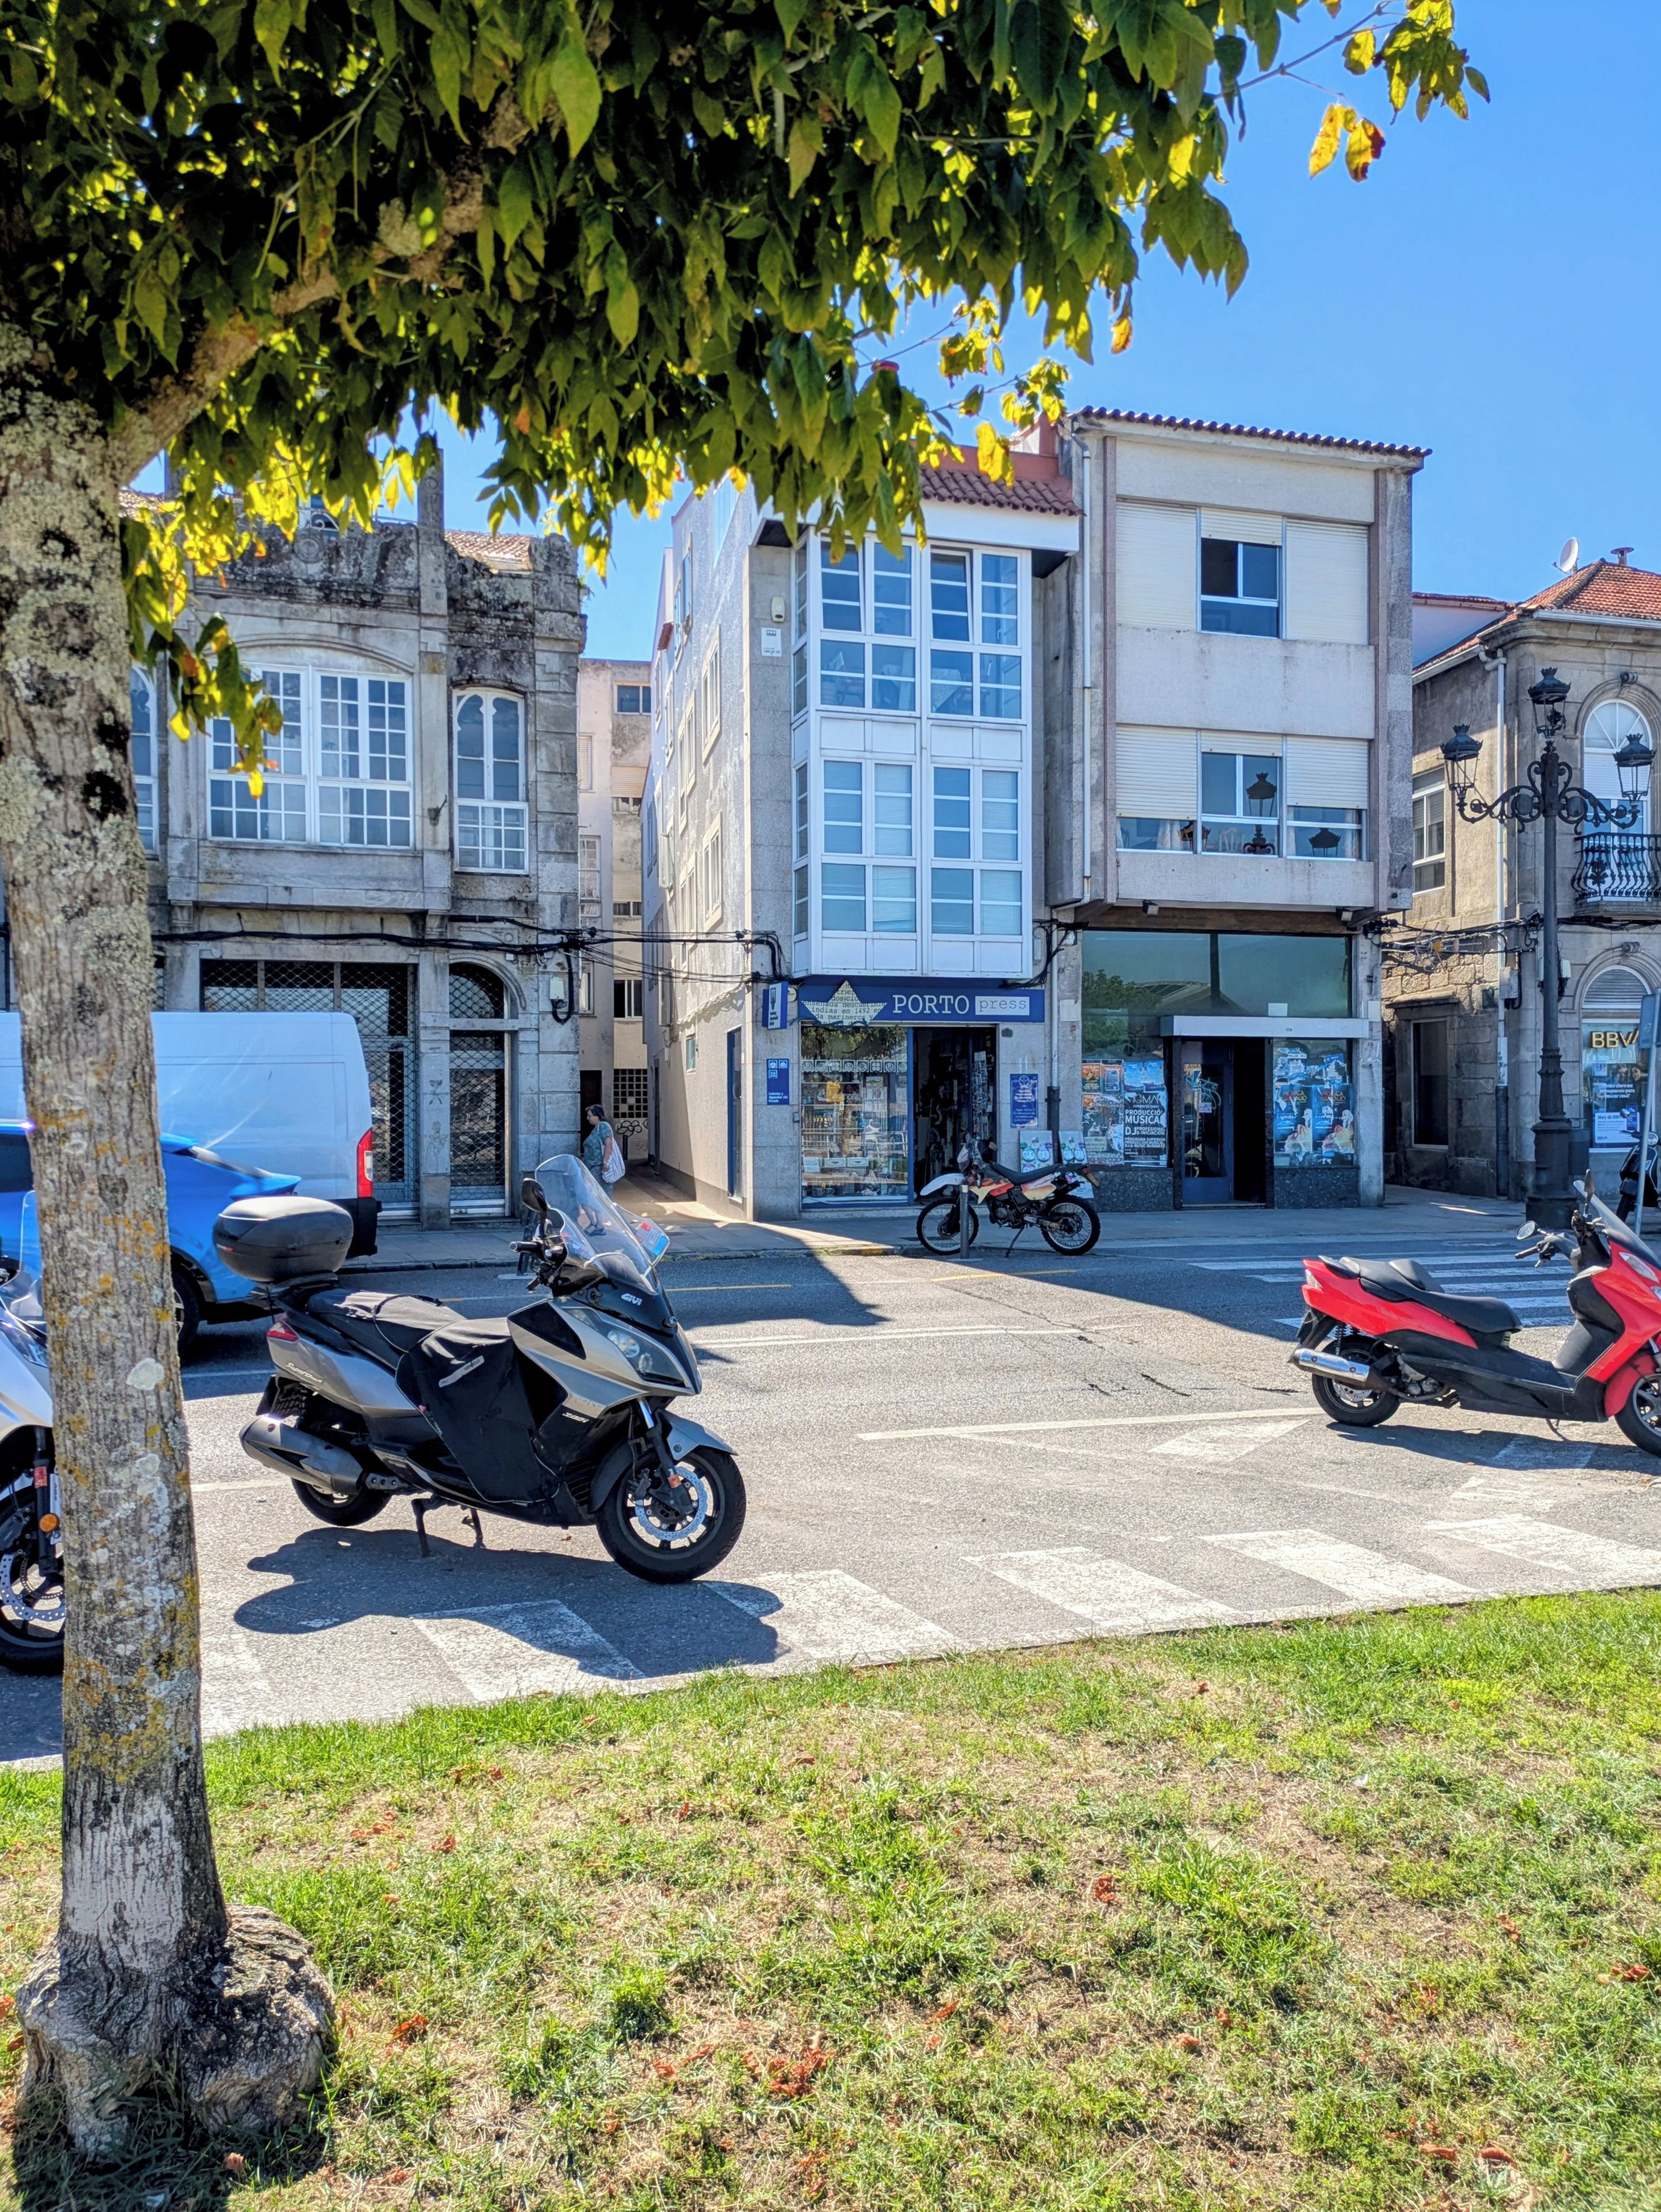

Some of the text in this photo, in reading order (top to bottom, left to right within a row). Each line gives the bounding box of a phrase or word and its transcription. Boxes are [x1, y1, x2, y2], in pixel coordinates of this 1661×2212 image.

[892, 994, 1027, 1014] PORTO press
[812, 1006, 838, 1014] indias
[1125, 1127, 1137, 1135] DJ
[621, 1293, 642, 1306] GIVI
